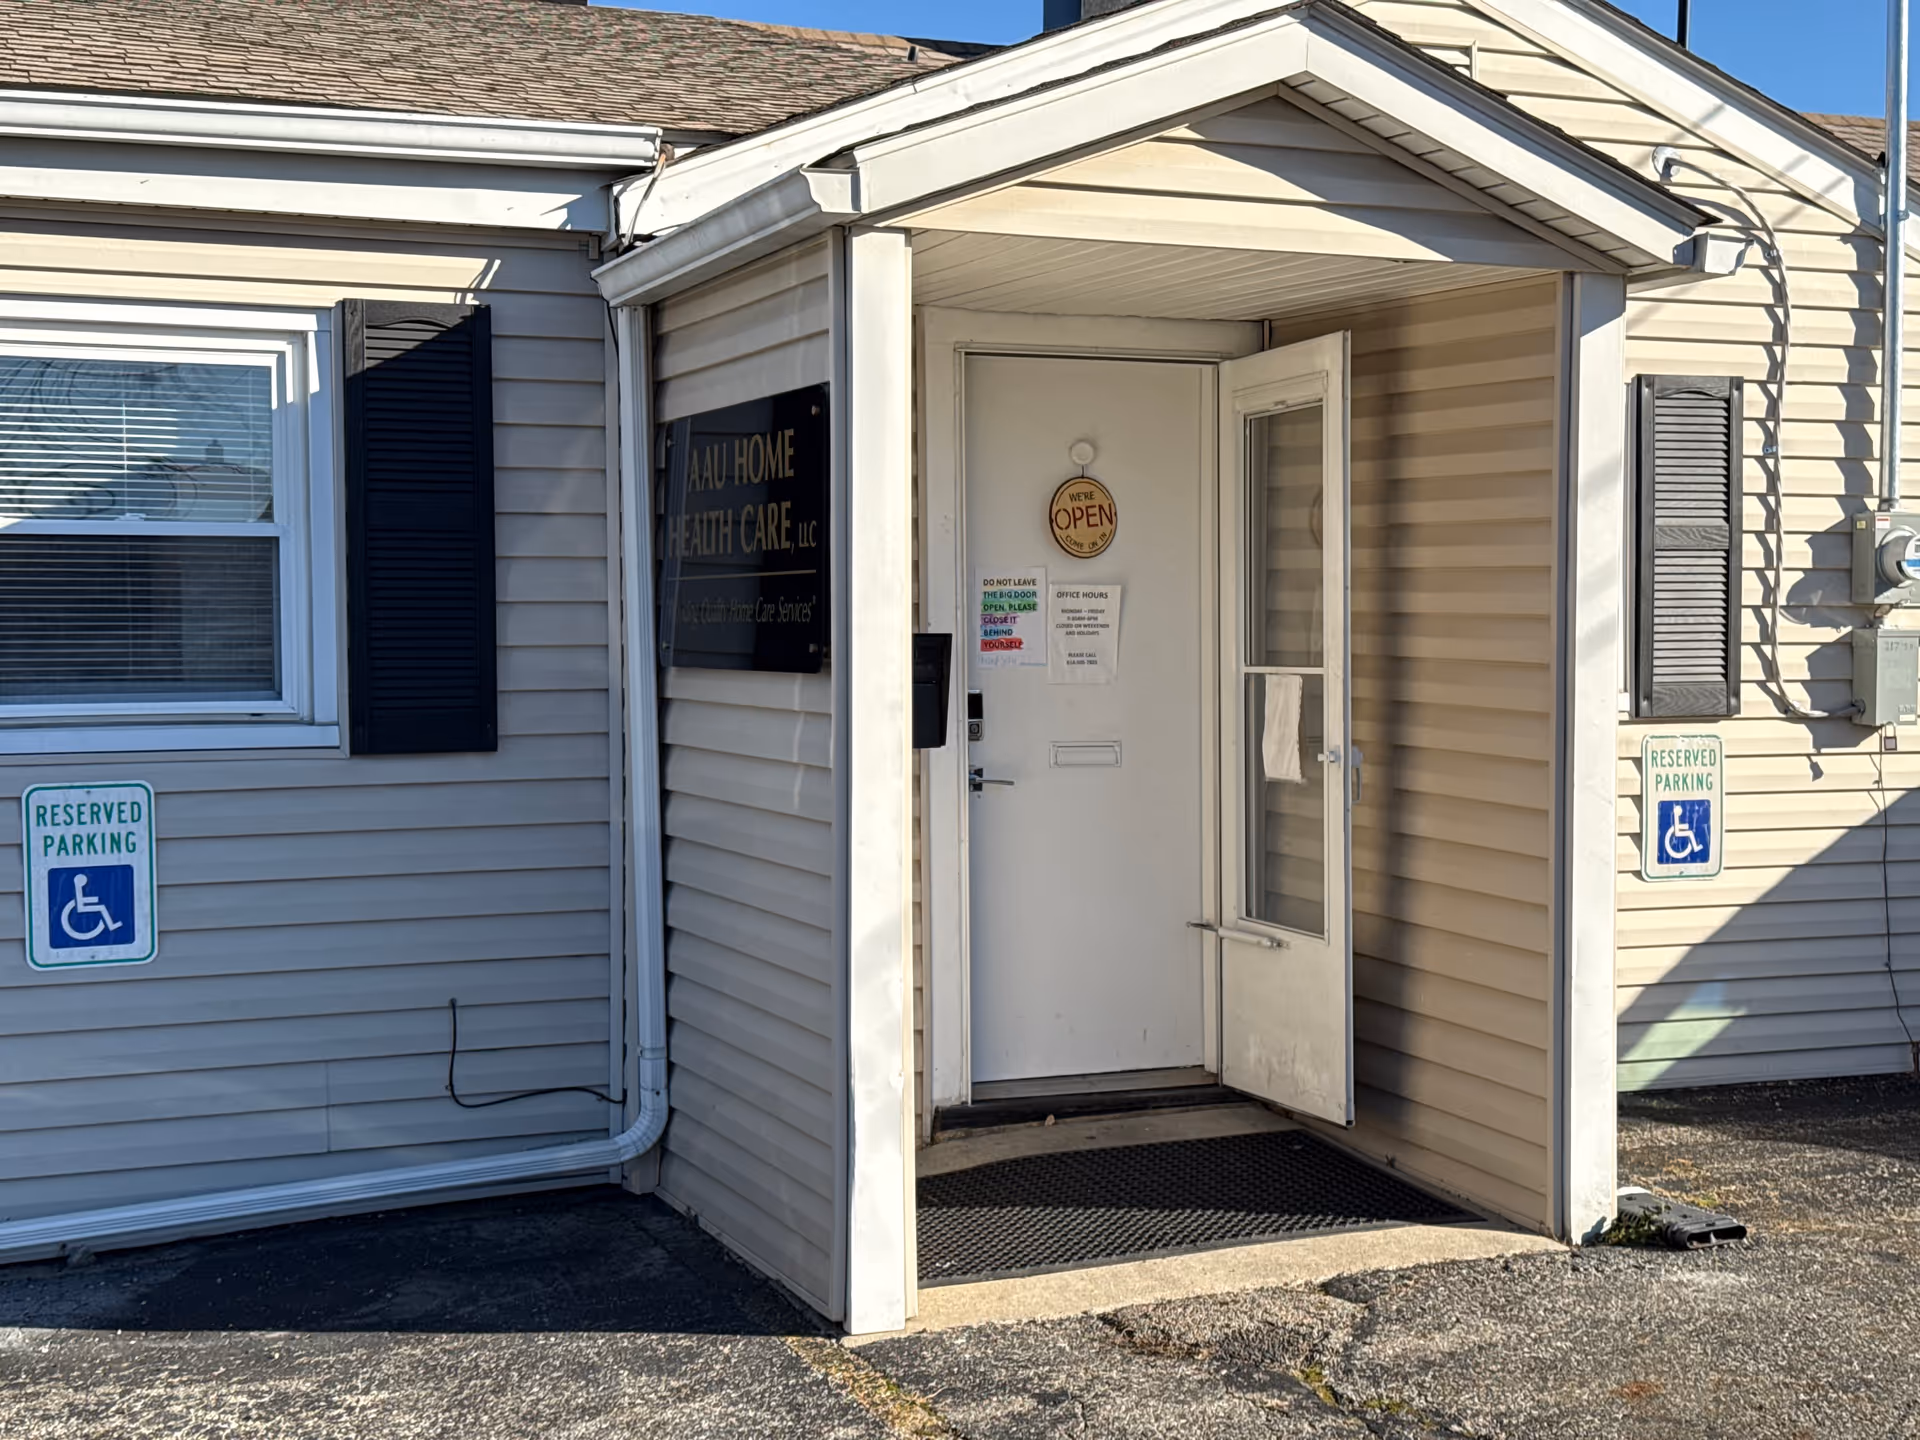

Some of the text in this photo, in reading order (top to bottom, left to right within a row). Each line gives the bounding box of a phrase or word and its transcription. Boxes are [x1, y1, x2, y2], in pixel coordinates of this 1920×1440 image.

[688, 428, 795, 493] AAU HOME
[1068, 490, 1096, 503] WE'RE
[1054, 502, 1114, 531] OPEN
[668, 500, 817, 559] HEALTH CARE, LLC
[1065, 531, 1108, 551] COME ON IN
[983, 578, 1037, 586] DO NOT LEAVE
[983, 591, 1037, 599] THE BIG DOOR
[1056, 591, 1108, 599] OFFICE HOURS
[755, 596, 775, 623] Care
[1008, 603, 1037, 611] PLEASE
[983, 616, 1017, 624] CLOSE IT
[983, 628, 1013, 637] BEHIND
[984, 640, 1024, 649] YOURSELF
[1651, 748, 1717, 769] RESERVED
[1655, 772, 1713, 793] PARKING
[36, 801, 142, 827] RESERVED
[43, 831, 137, 857] PARKING
